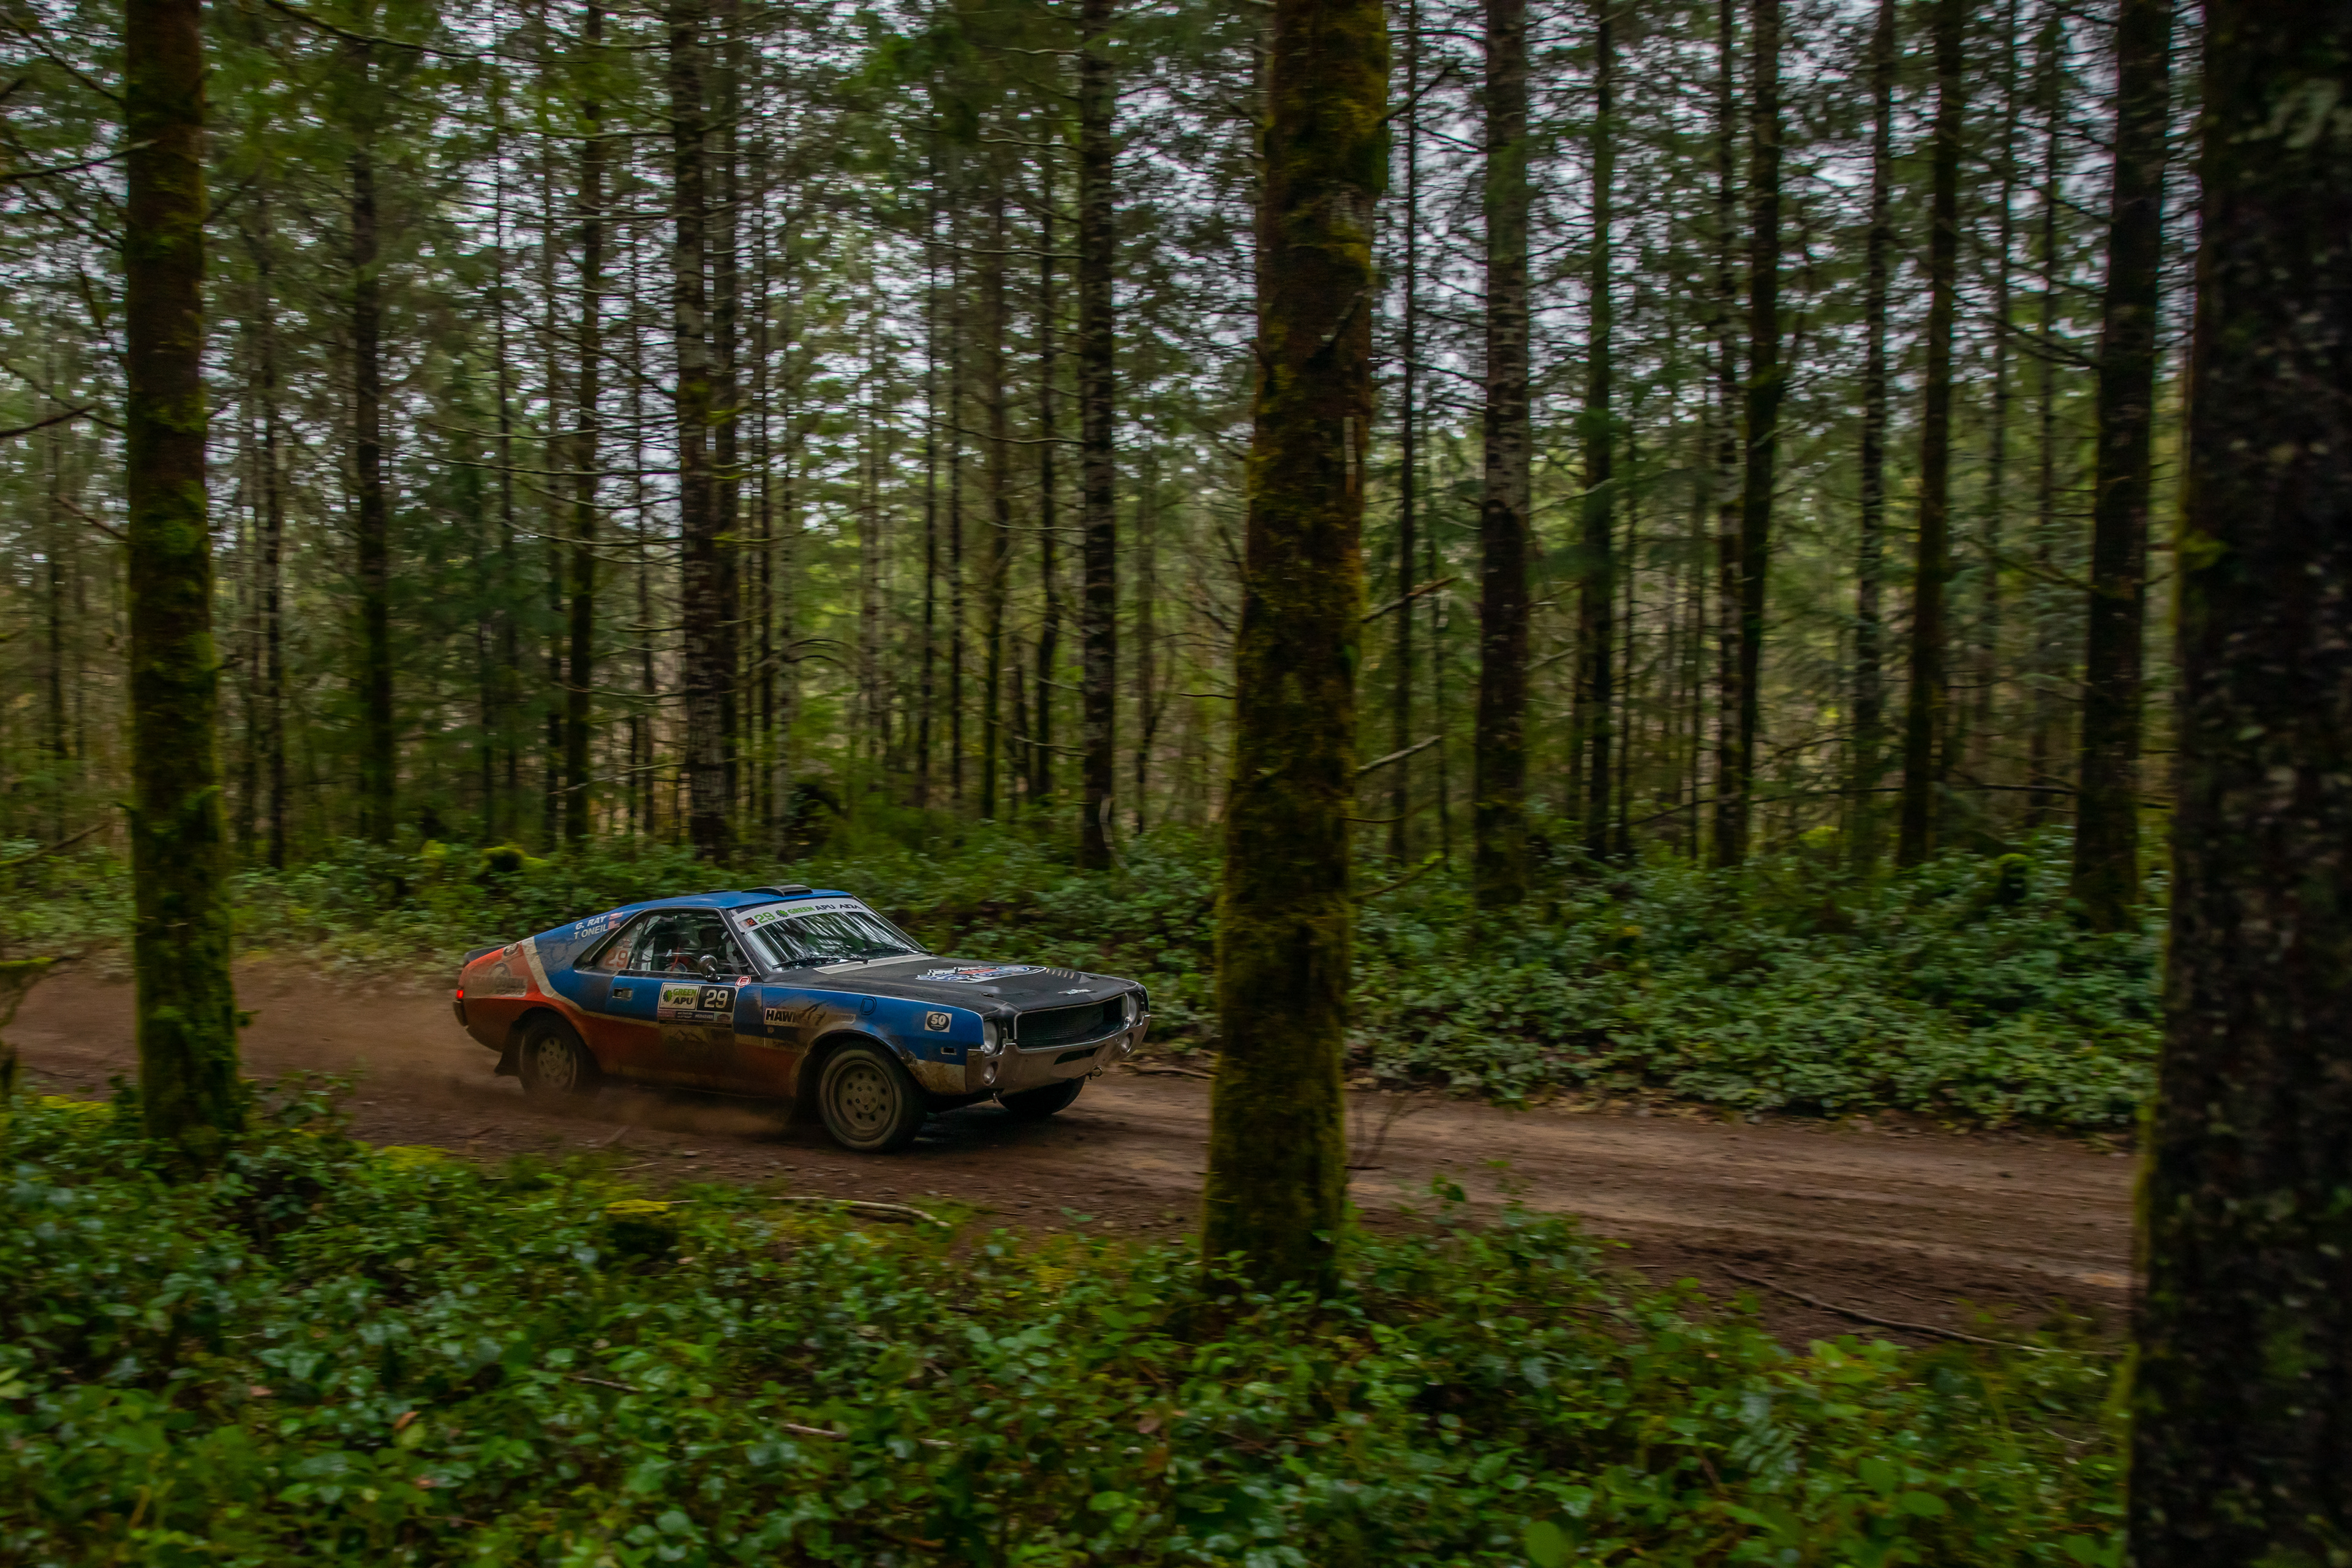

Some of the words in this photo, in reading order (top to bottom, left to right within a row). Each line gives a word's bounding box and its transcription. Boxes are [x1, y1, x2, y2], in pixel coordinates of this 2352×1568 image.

[587, 916, 607, 927] RAY
[754, 912, 776, 923] 29
[787, 906, 815, 914] GREEN
[581, 924, 608, 938] ONEIL
[605, 950, 628, 968] 29
[704, 990, 728, 1008] 29
[930, 1014, 946, 1025] 50
